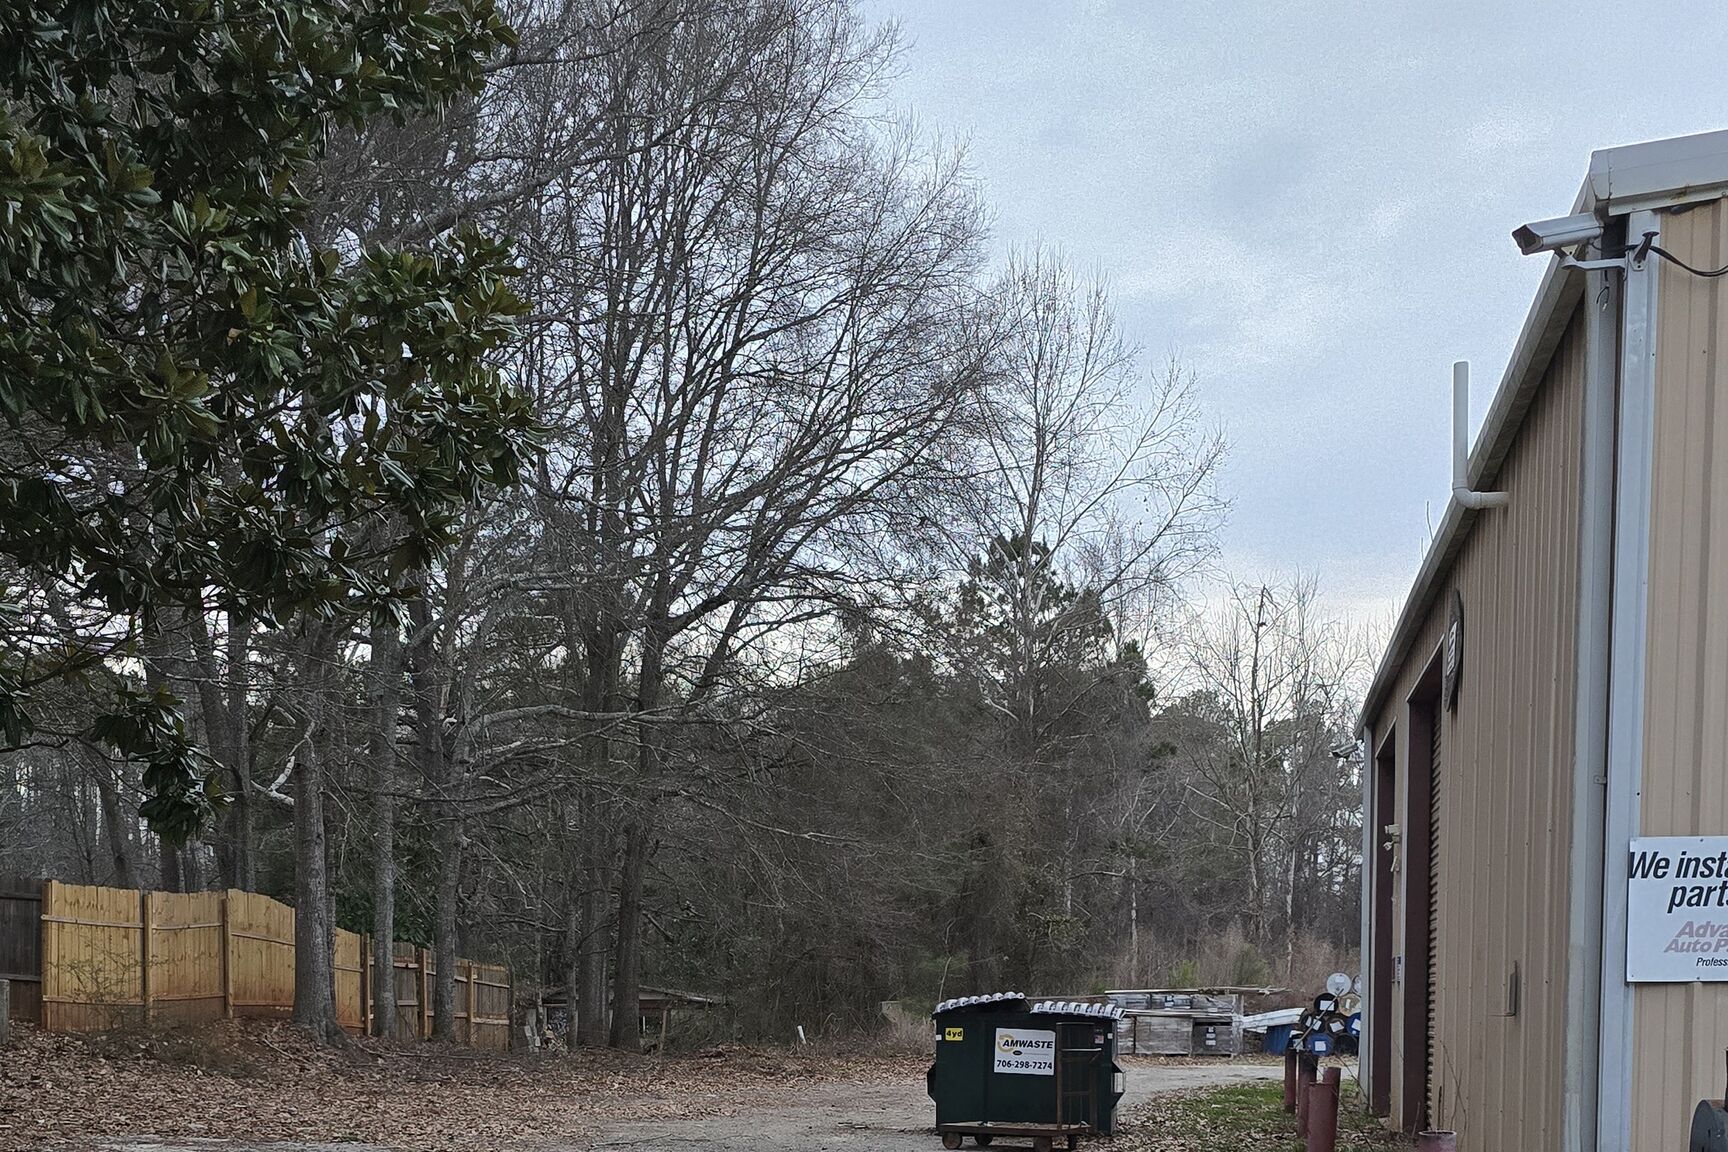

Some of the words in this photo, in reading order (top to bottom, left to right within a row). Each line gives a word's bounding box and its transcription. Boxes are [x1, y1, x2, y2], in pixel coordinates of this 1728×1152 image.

[1629, 851, 1670, 879] We
[1675, 851, 1728, 879] inst
[1667, 880, 1728, 914] part
[1003, 1039, 1053, 1049] AMWASTE
[997, 1059, 1053, 1070] 706-298-7274
